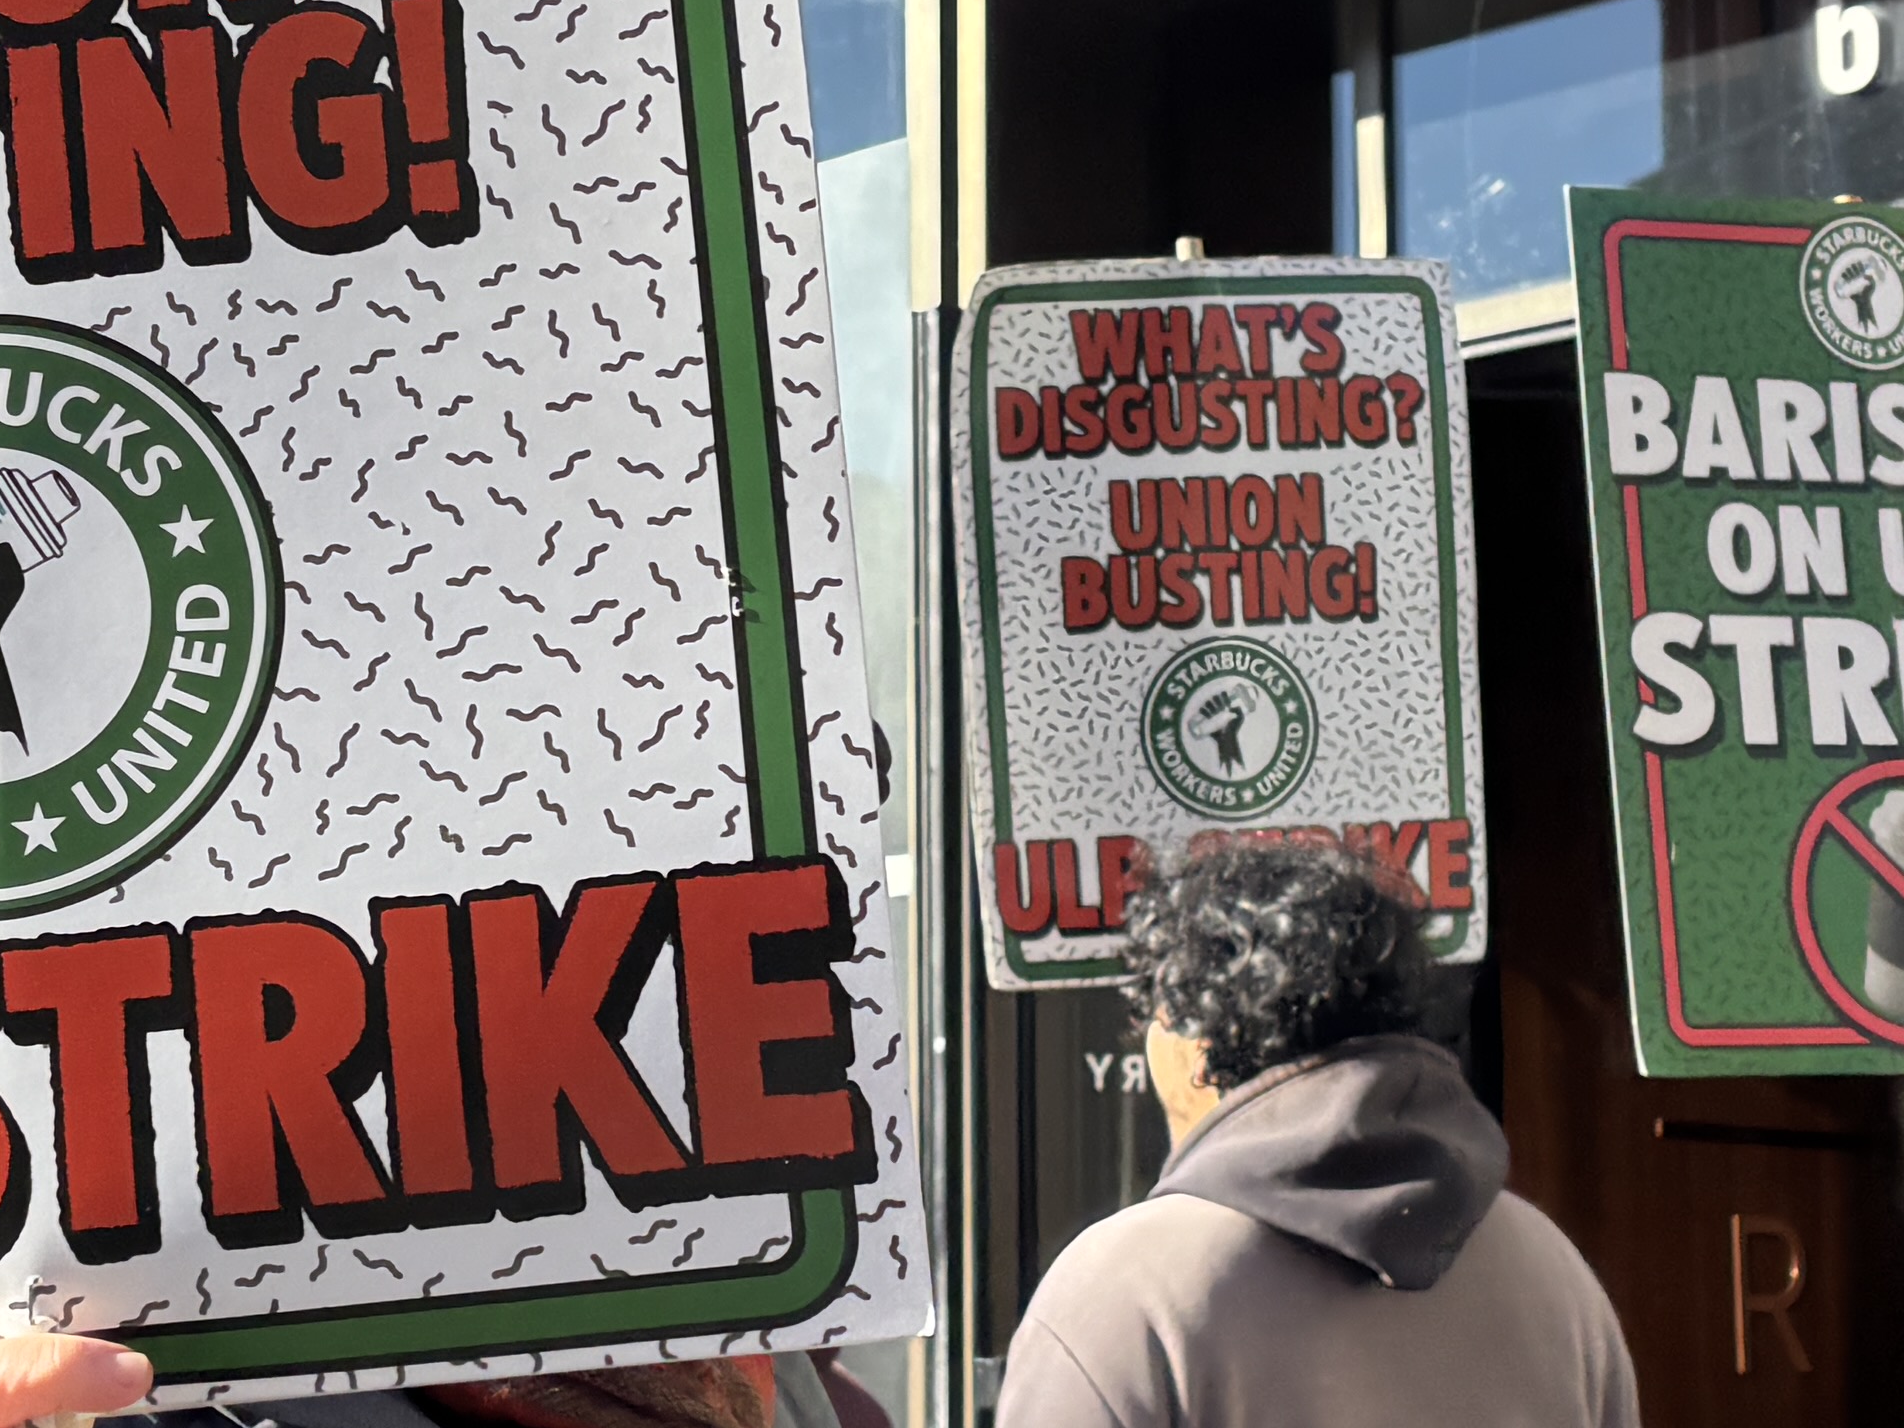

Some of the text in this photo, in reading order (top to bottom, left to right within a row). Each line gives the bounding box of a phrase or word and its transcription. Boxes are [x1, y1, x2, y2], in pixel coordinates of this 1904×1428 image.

[1069, 301, 1344, 382] WHAT'S
[1809, 287, 1873, 360] WORKERS
[994, 372, 1425, 460] DISGUSTING?
[1107, 473, 1326, 553] UNION
[1707, 502, 1848, 598] ON
[1061, 542, 1380, 633] BUSTING!
[71, 584, 231, 825] UNITED
[1167, 651, 1291, 700] STARBUCKS
[1156, 722, 1304, 806] WORKERS UNITED
[994, 834, 1152, 934] ULP
